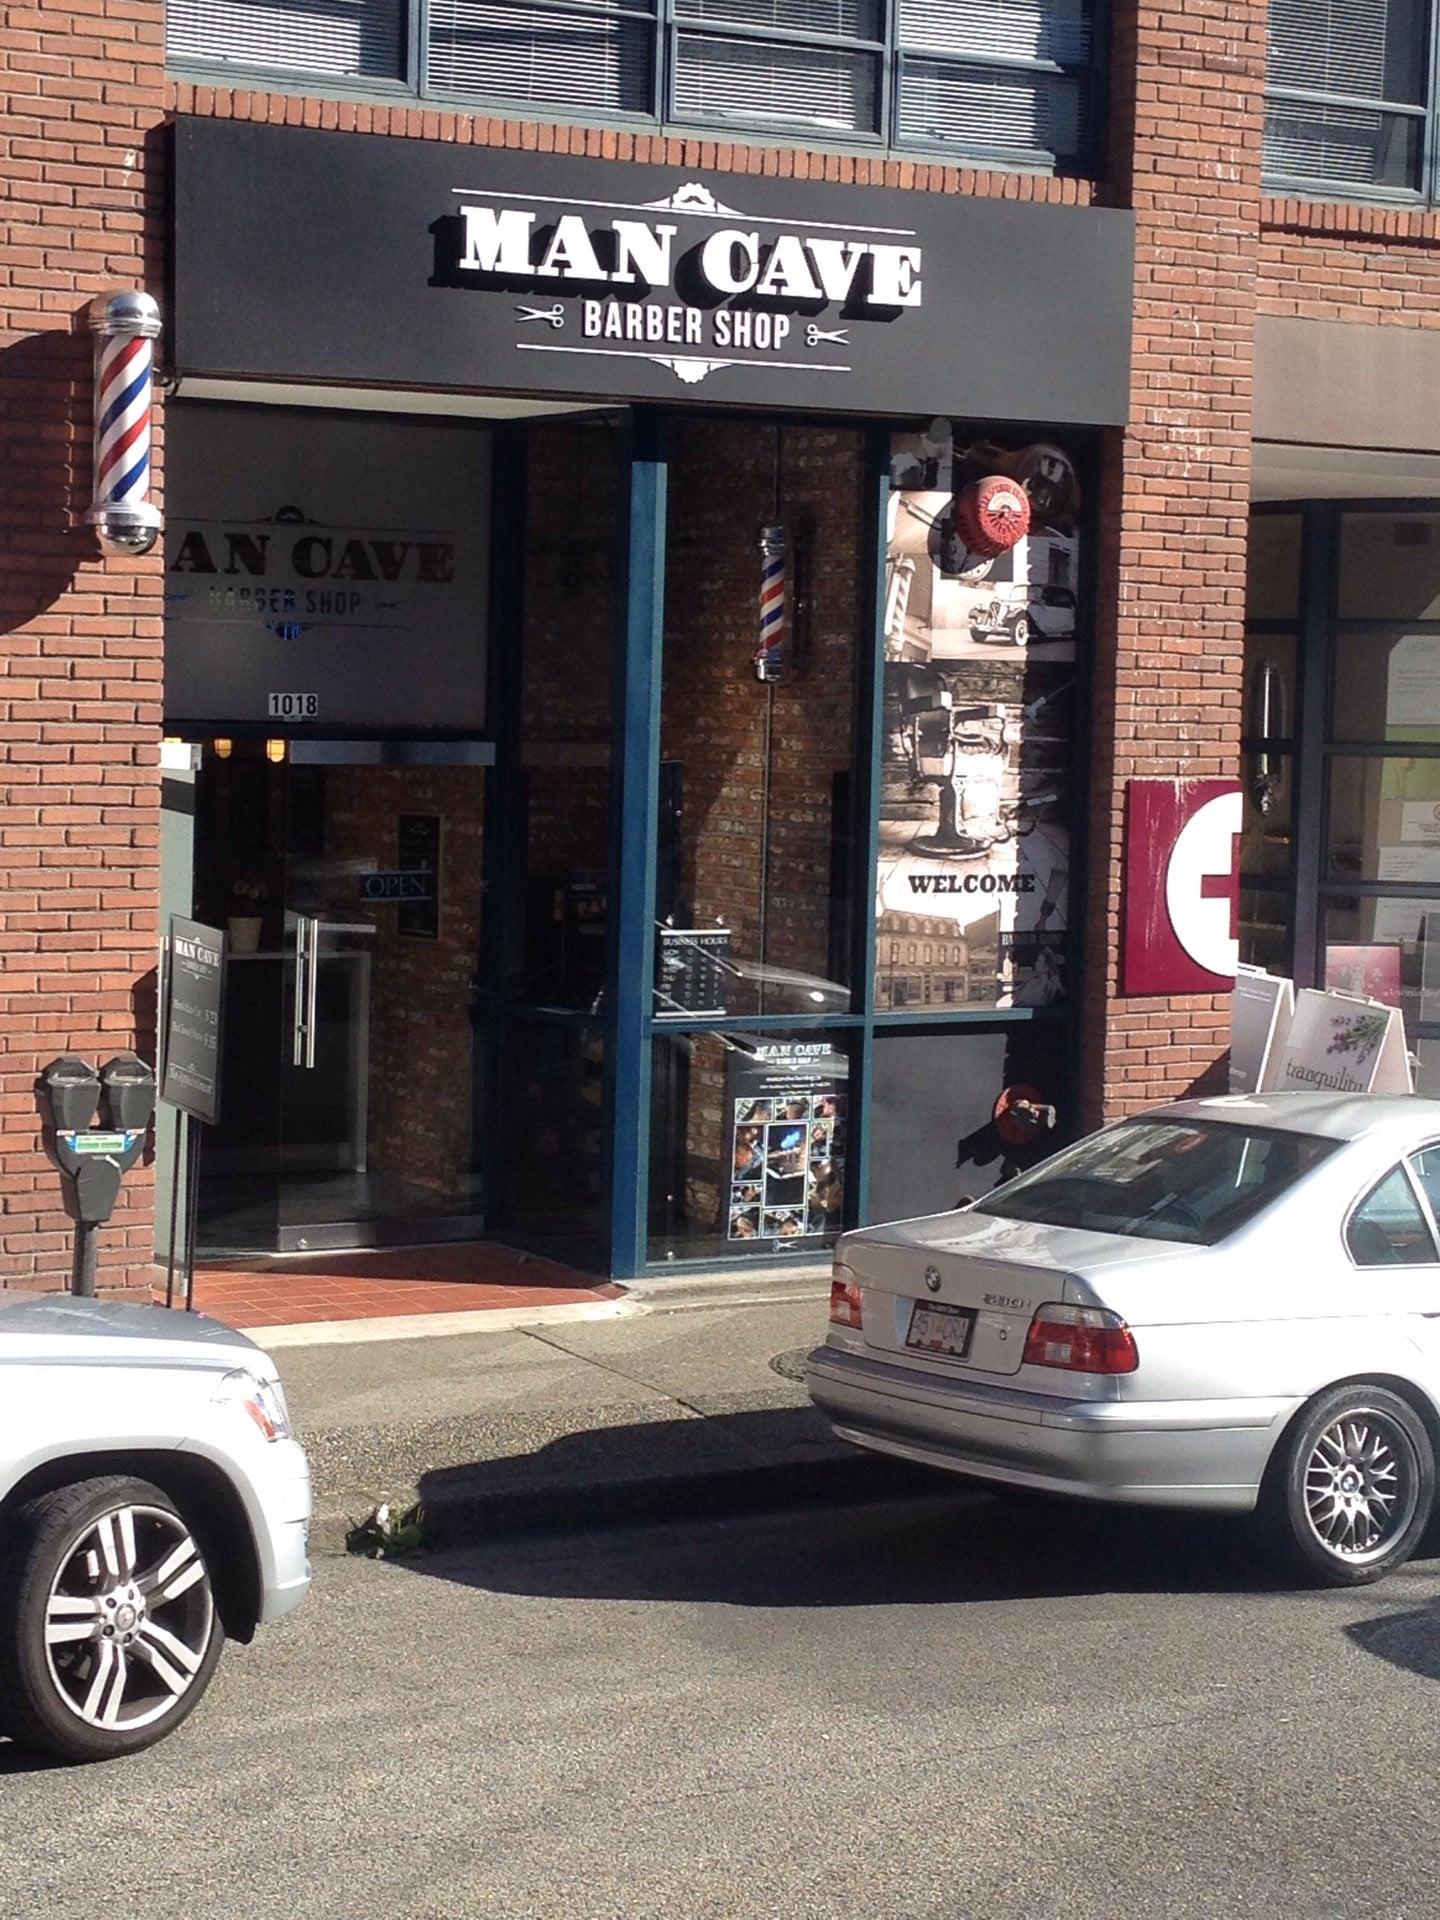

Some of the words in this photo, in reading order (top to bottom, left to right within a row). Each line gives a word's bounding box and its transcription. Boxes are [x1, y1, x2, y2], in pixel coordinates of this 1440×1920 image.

[458, 206, 678, 286] MAN
[702, 229, 922, 307] CAVE
[583, 301, 702, 344] BARBER
[715, 310, 790, 350] SHOP
[168, 531, 271, 575] AN
[291, 535, 455, 583] CAVE
[305, 590, 363, 616] SHOP
[271, 695, 317, 715] 1018
[366, 875, 426, 896] OPEN
[908, 874, 1036, 893] WELCOME
[662, 937, 698, 946] BUSINESS
[700, 936, 728, 945] HOURS
[174, 939, 196, 960] MAN
[197, 947, 219, 967] CAVE
[756, 1045, 791, 1058] MAN
[794, 1043, 832, 1056] CAVE
